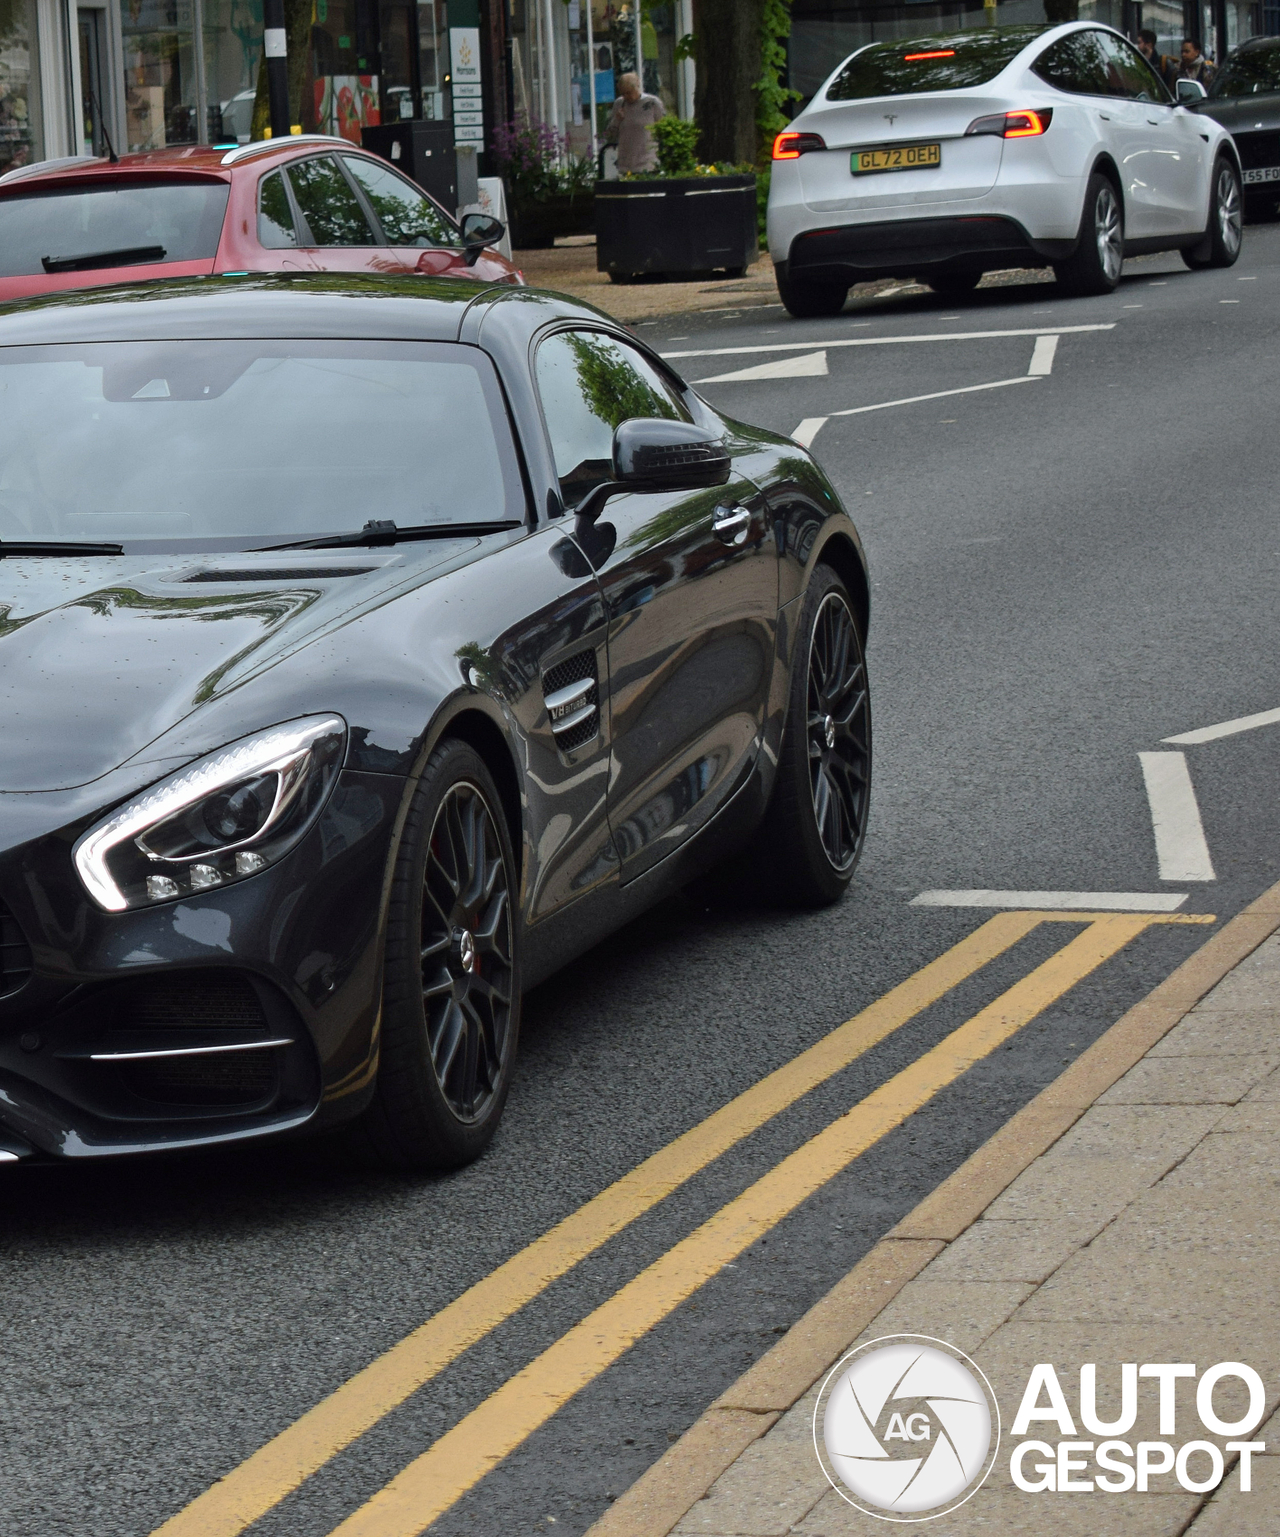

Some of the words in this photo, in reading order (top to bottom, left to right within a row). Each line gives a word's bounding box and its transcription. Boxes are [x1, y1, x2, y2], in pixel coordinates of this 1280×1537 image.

[861, 150, 902, 168] GL72
[907, 146, 938, 163] OEH
[551, 705, 565, 720] V8
